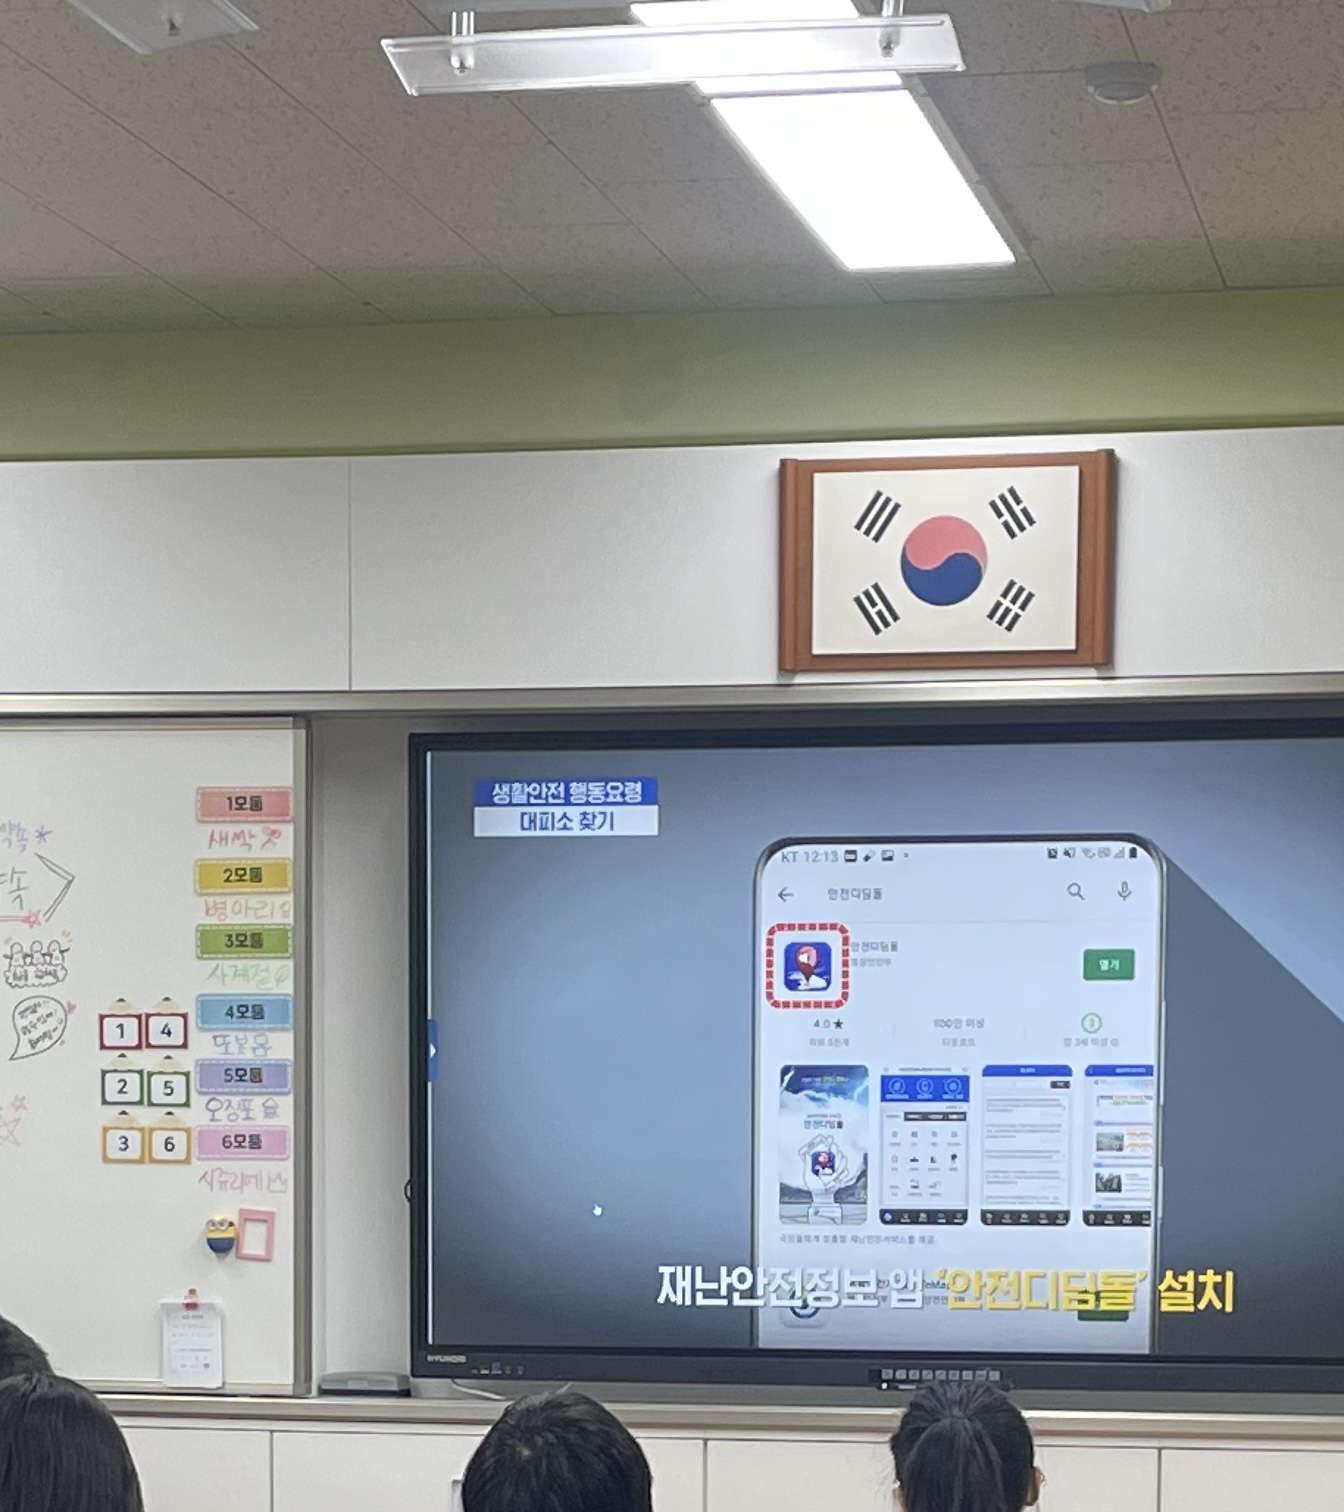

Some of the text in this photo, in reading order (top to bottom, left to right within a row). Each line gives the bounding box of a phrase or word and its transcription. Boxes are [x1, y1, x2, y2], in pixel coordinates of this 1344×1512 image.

[492, 781, 642, 804] 생활안전 행동요령
[520, 811, 614, 831] 대피소 찾기
[208, 829, 256, 852] 새싹
[781, 851, 839, 863] KT 12:13
[204, 899, 274, 922] 병아리
[115, 1022, 173, 1039] 1 4
[117, 1078, 174, 1096] 2 5
[118, 1135, 176, 1152] 3 6
[657, 1265, 879, 1308] 재난안전정보
[890, 1268, 923, 1308] 앱
[1159, 1269, 1234, 1313] 설치
